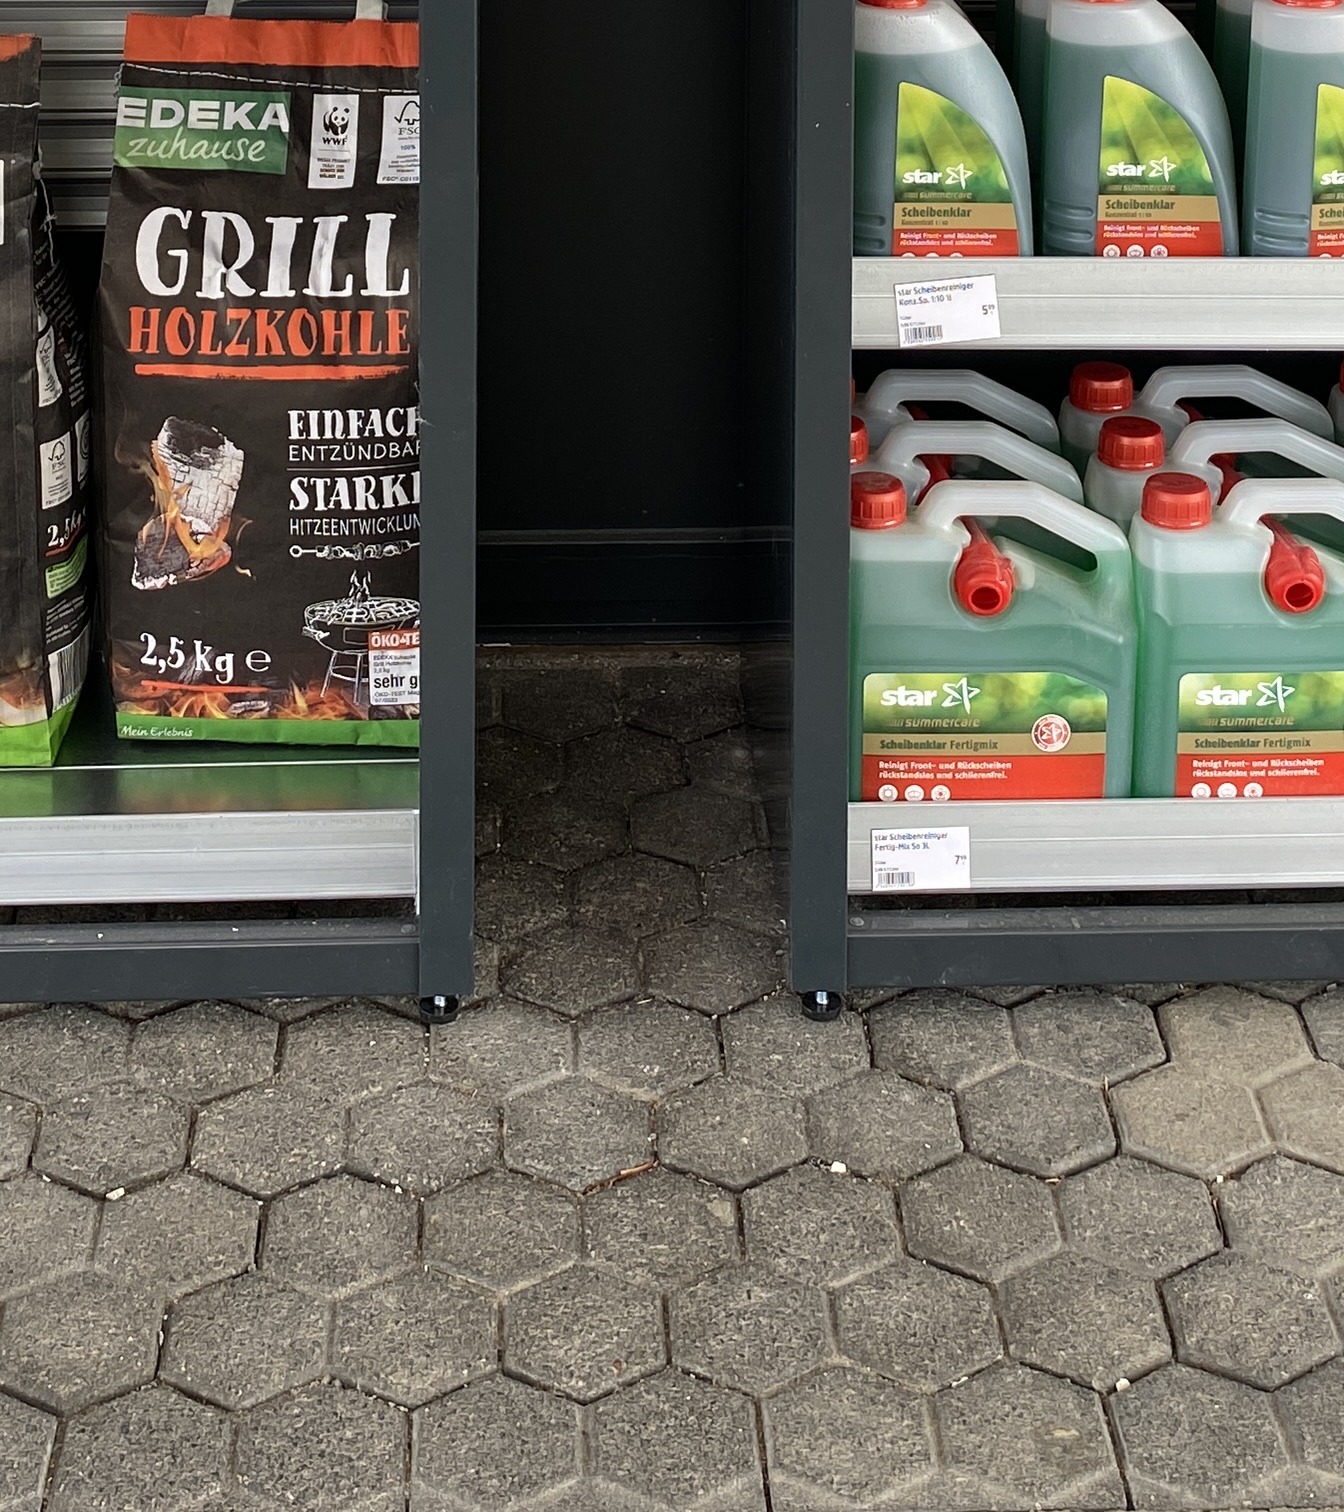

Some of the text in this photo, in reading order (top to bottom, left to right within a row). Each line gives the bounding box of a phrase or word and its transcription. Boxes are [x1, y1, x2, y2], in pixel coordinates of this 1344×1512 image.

[116, 96, 289, 133] EDEKA
[126, 126, 266, 162] zuhause
[322, 136, 348, 146] WWF
[902, 168, 942, 185] star
[1106, 161, 1147, 178] star
[1105, 198, 1175, 211] Scheibenklar
[901, 206, 972, 219] Scheibenklar
[135, 206, 409, 298] GRILL
[898, 282, 974, 296] star Scheibenreiniger
[127, 306, 410, 357] HOLZKOHLE
[374, 675, 405, 689] sehr
[880, 685, 937, 707] star
[1195, 684, 1252, 706] star
[905, 718, 980, 728] summercare
[120, 726, 193, 737] Mein Erlebnis
[880, 739, 998, 751] Scheibenklar Fertigmix
[1194, 737, 1311, 750] Scheibenklar Fertigmix
